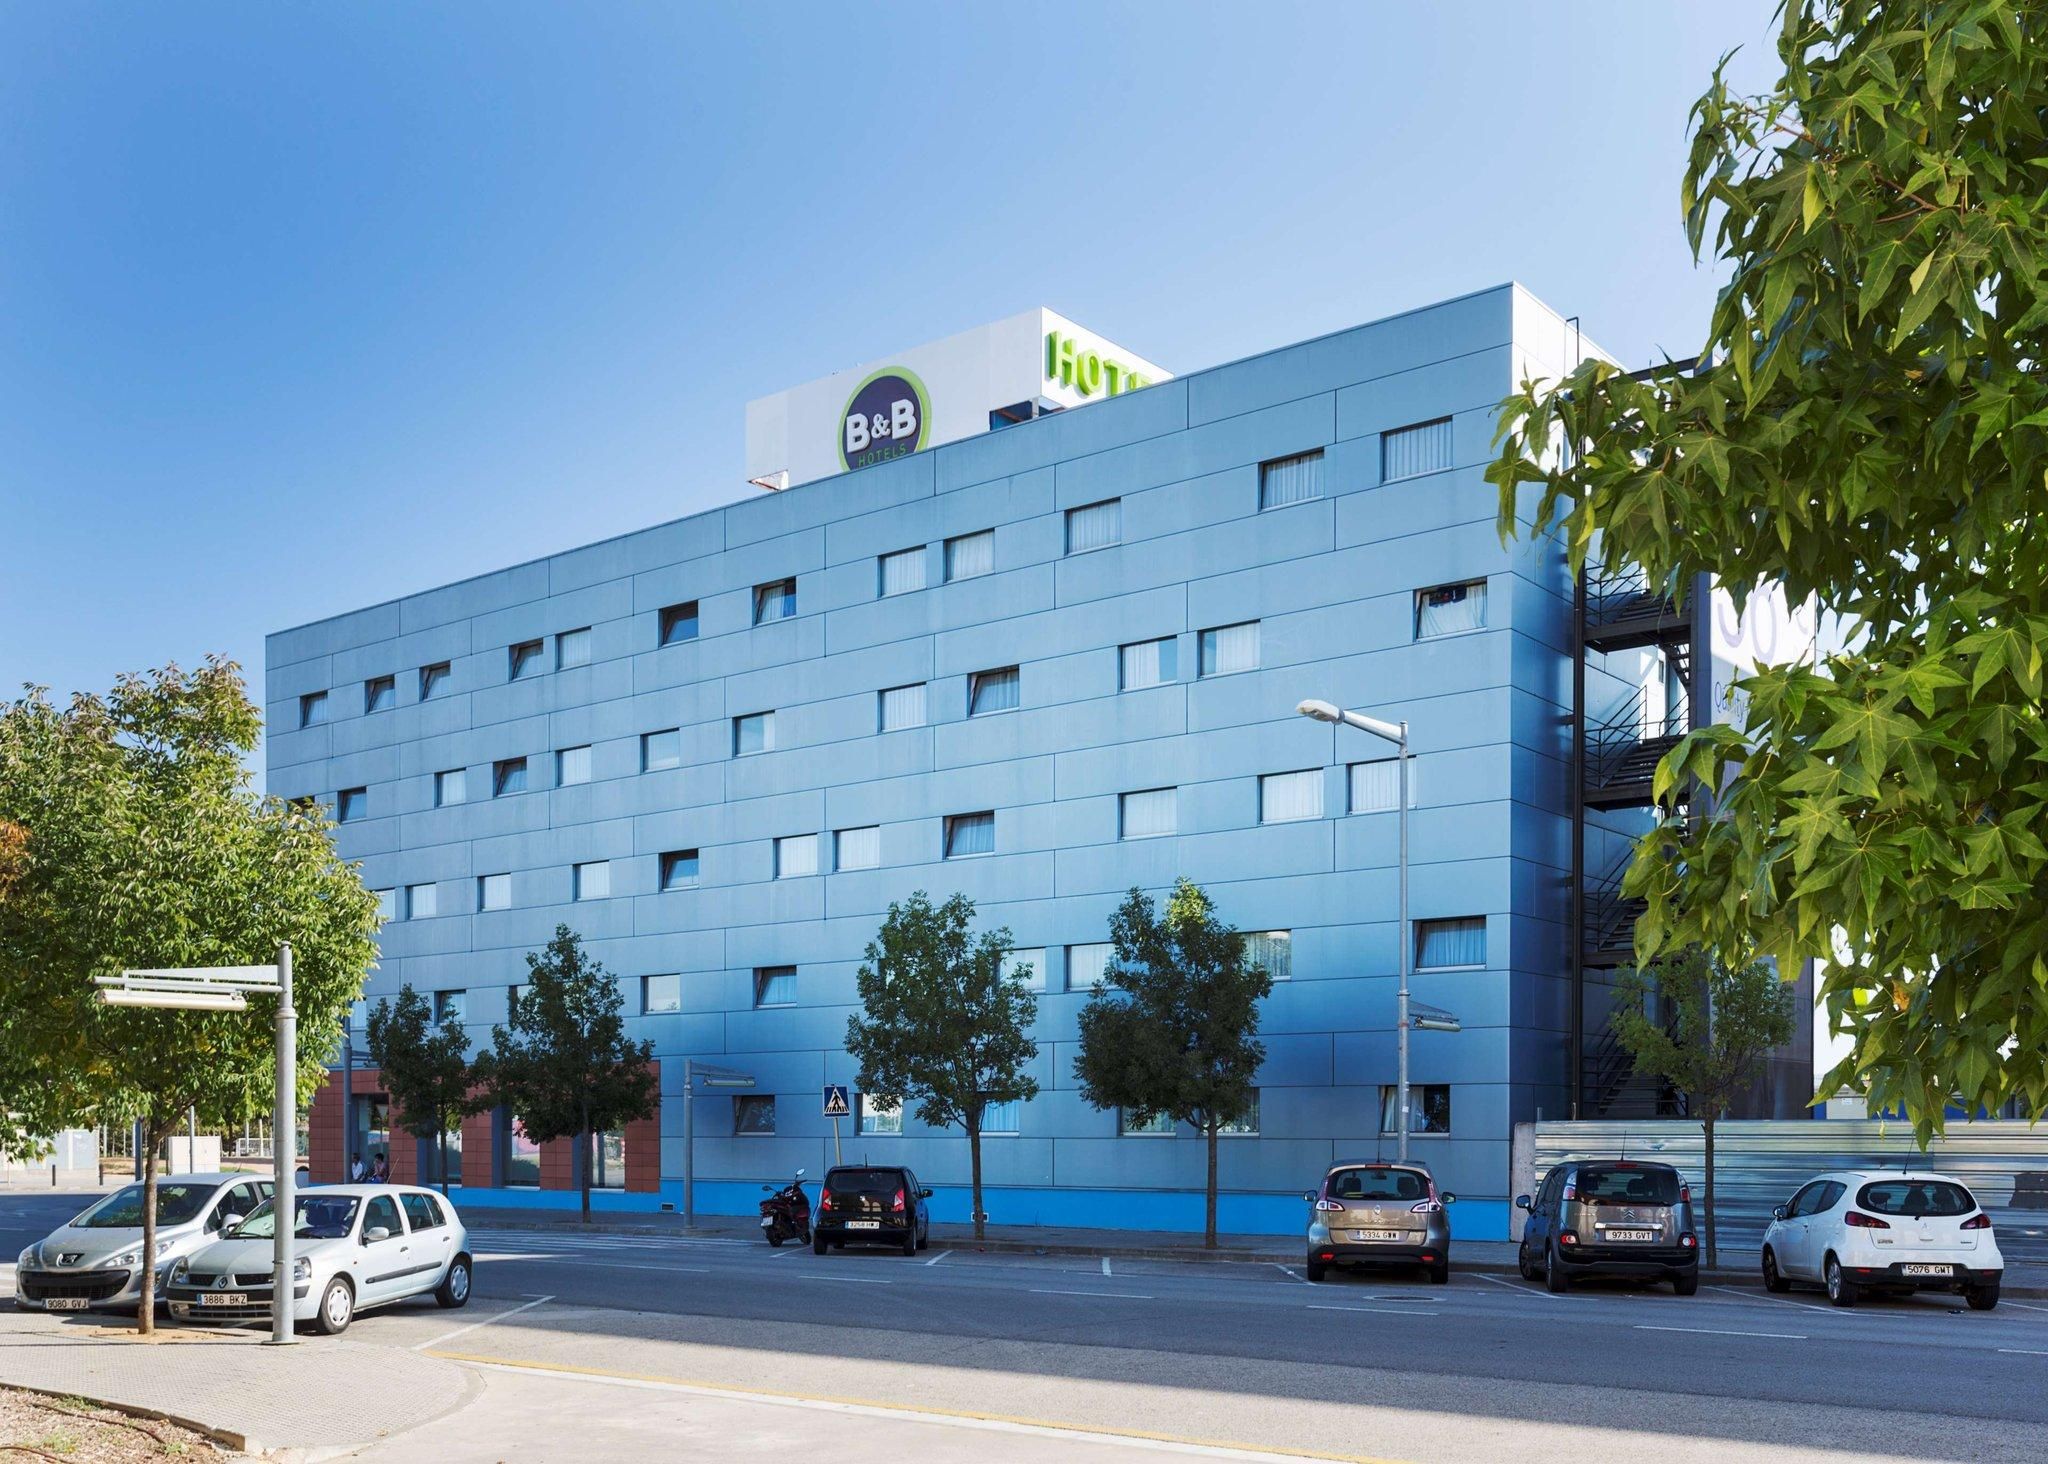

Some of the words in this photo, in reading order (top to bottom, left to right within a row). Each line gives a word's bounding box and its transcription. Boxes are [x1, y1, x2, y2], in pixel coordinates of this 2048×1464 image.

[846, 398, 917, 453] B&B
[858, 443, 907, 467] HOTELS
[1611, 1231, 1632, 1239] 9733
[1635, 1231, 1651, 1239] GVT
[1907, 1265, 1930, 1274] 5076
[203, 1295, 225, 1305] 3886
